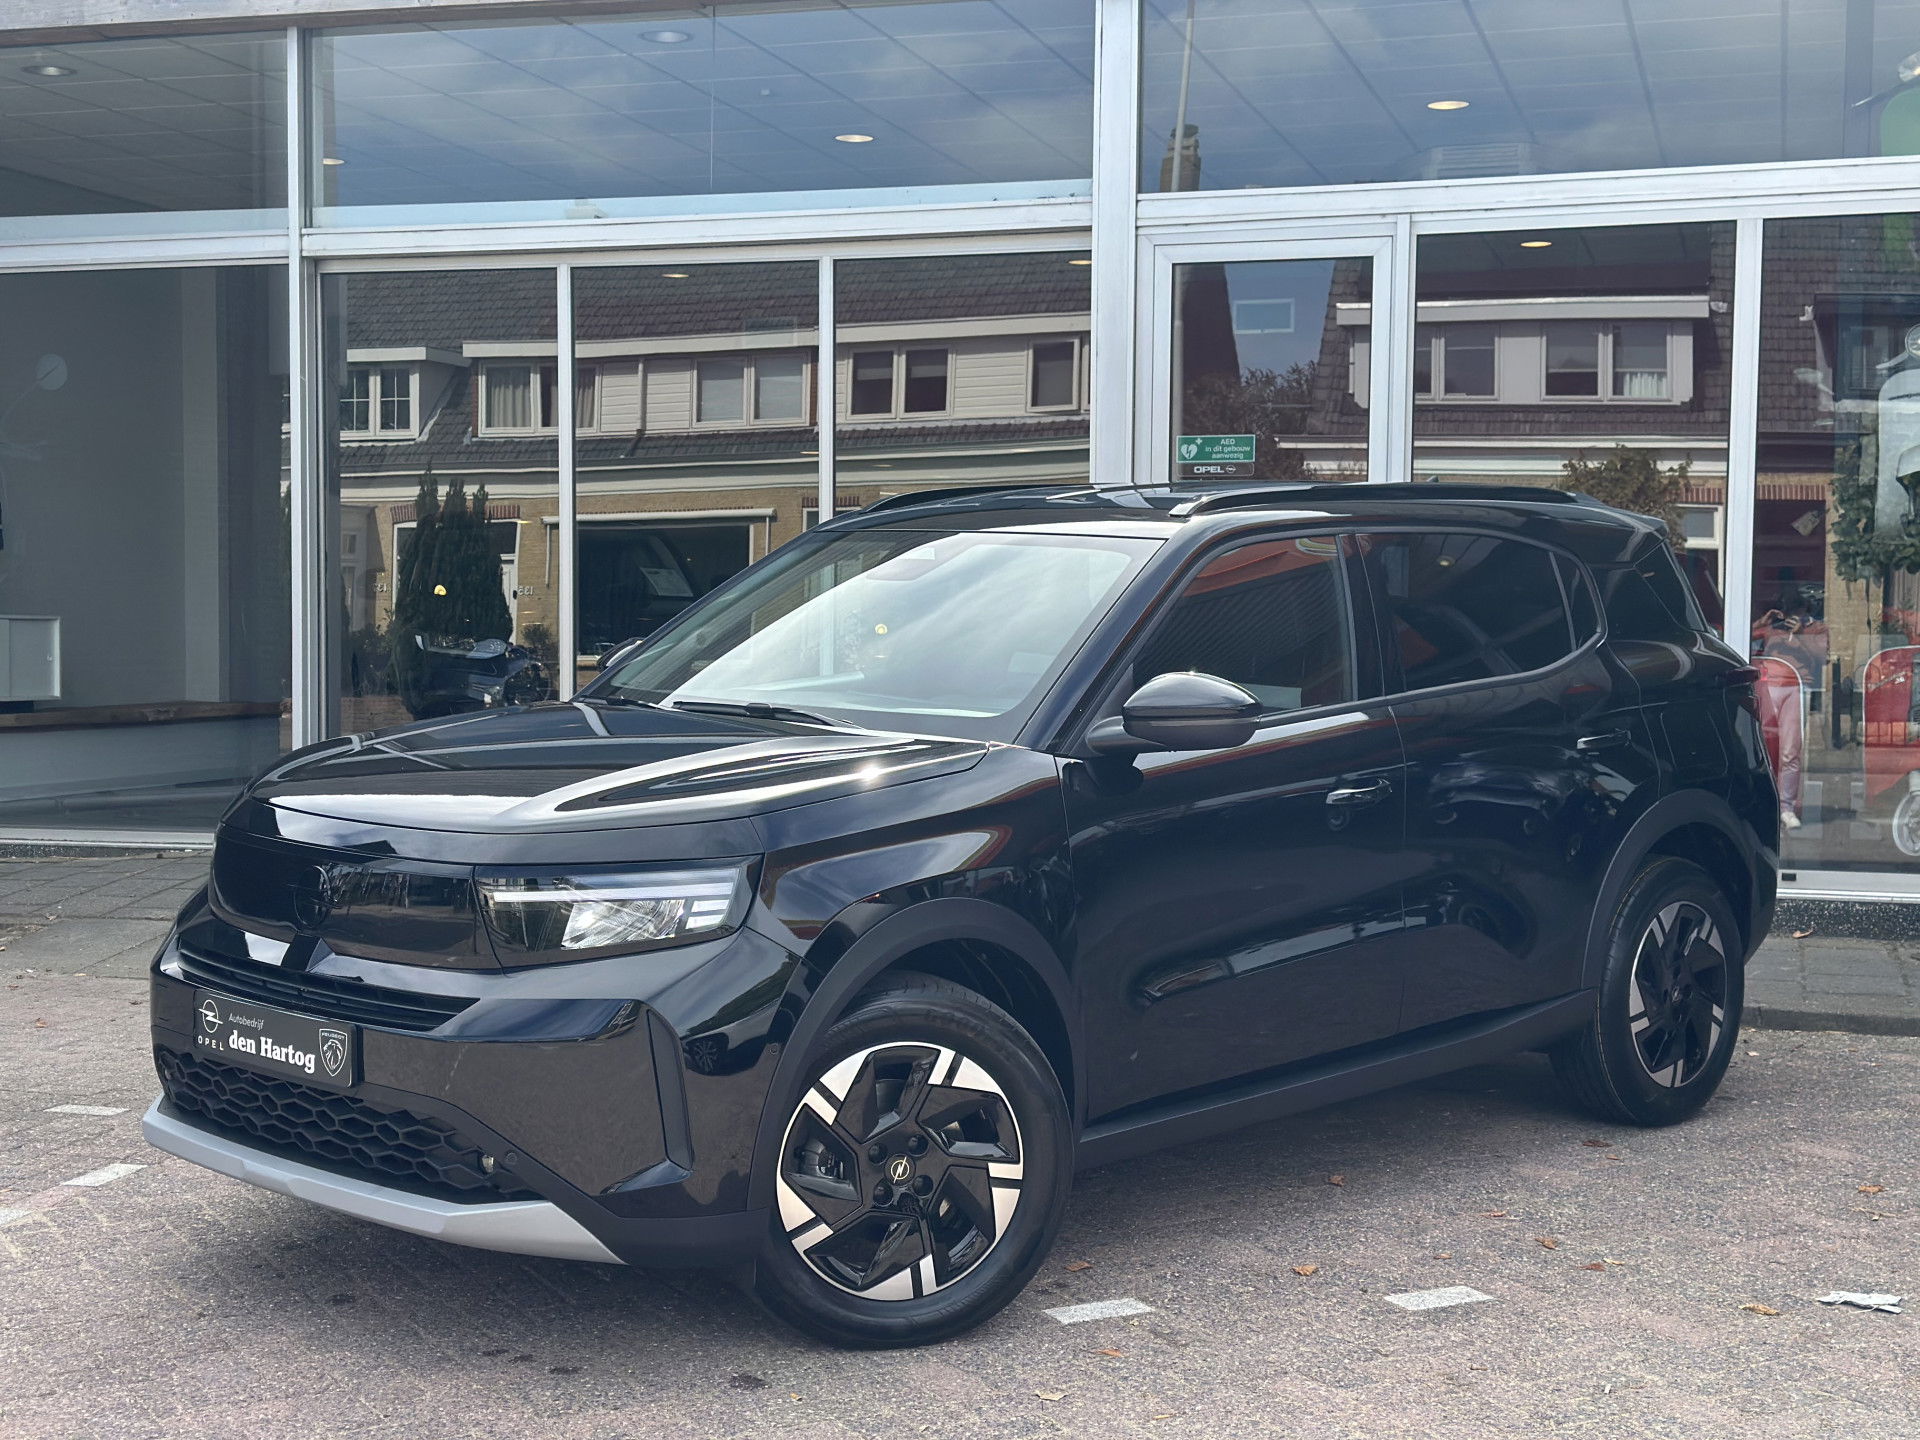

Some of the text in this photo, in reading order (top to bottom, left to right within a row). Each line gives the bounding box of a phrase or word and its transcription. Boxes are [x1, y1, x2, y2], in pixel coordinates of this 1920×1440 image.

[1193, 465, 1225, 474] OPEL
[228, 1012, 265, 1031] Autobedrijf
[197, 1035, 225, 1051] OPEL
[228, 1029, 316, 1074] den Hartog
